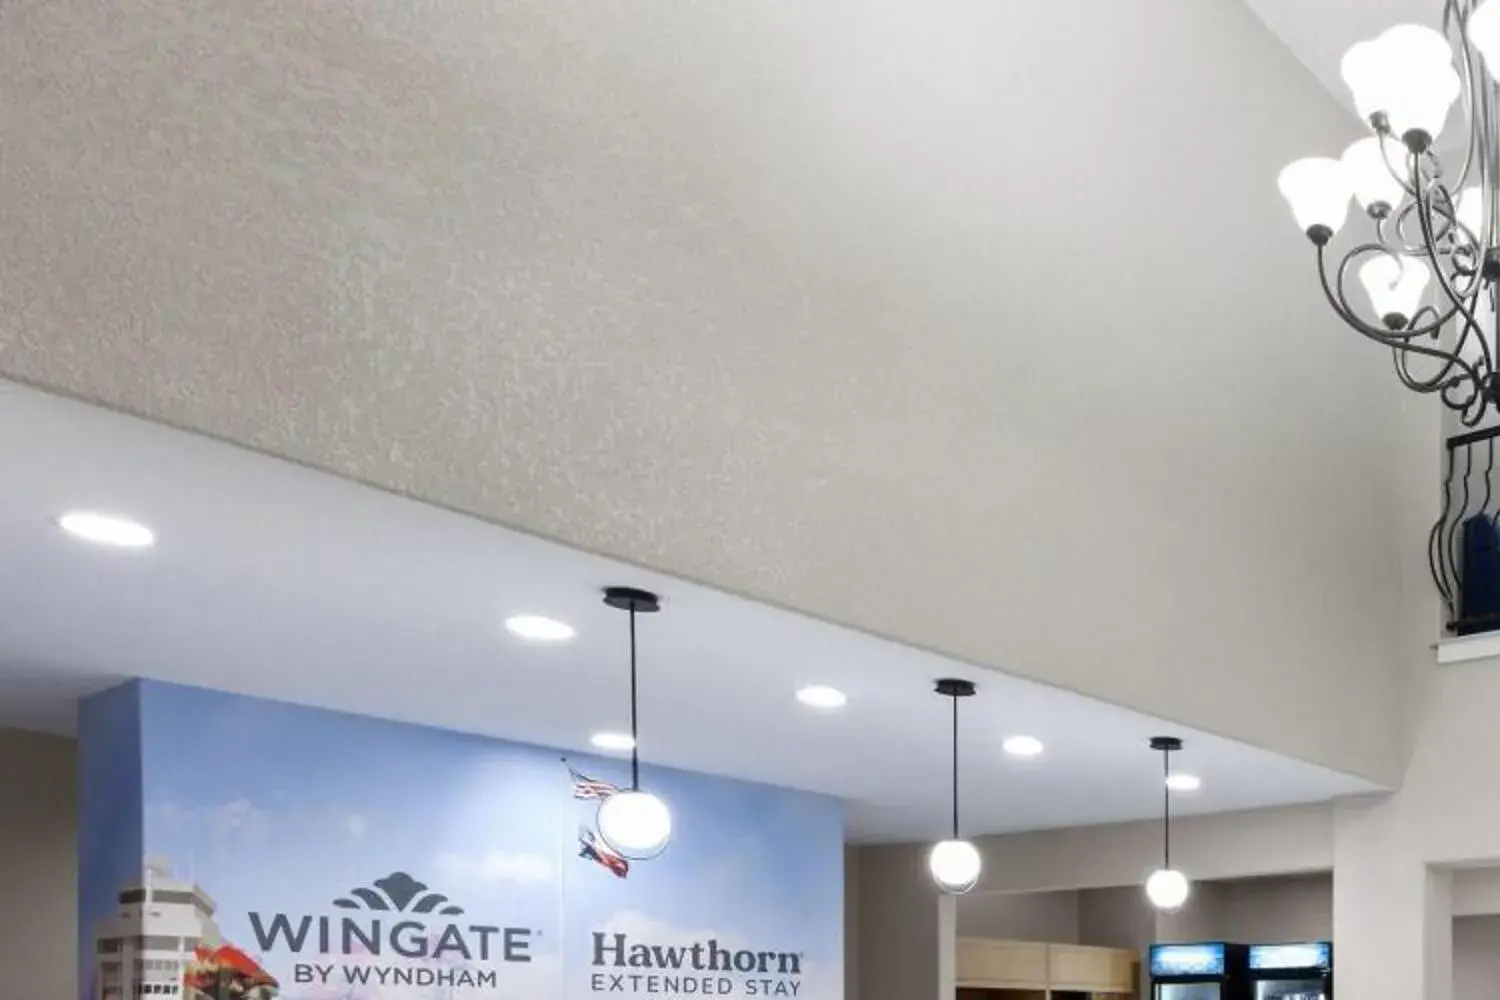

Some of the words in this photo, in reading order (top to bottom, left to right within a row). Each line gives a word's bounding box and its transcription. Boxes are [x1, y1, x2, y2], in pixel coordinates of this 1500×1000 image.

[248, 911, 532, 962] WINGATE
[591, 931, 802, 974] Hawthorn
[294, 963, 334, 984] BY
[343, 965, 497, 988] WYNDHAM
[591, 973, 733, 995] EXTENDED
[745, 978, 801, 997] STAY
